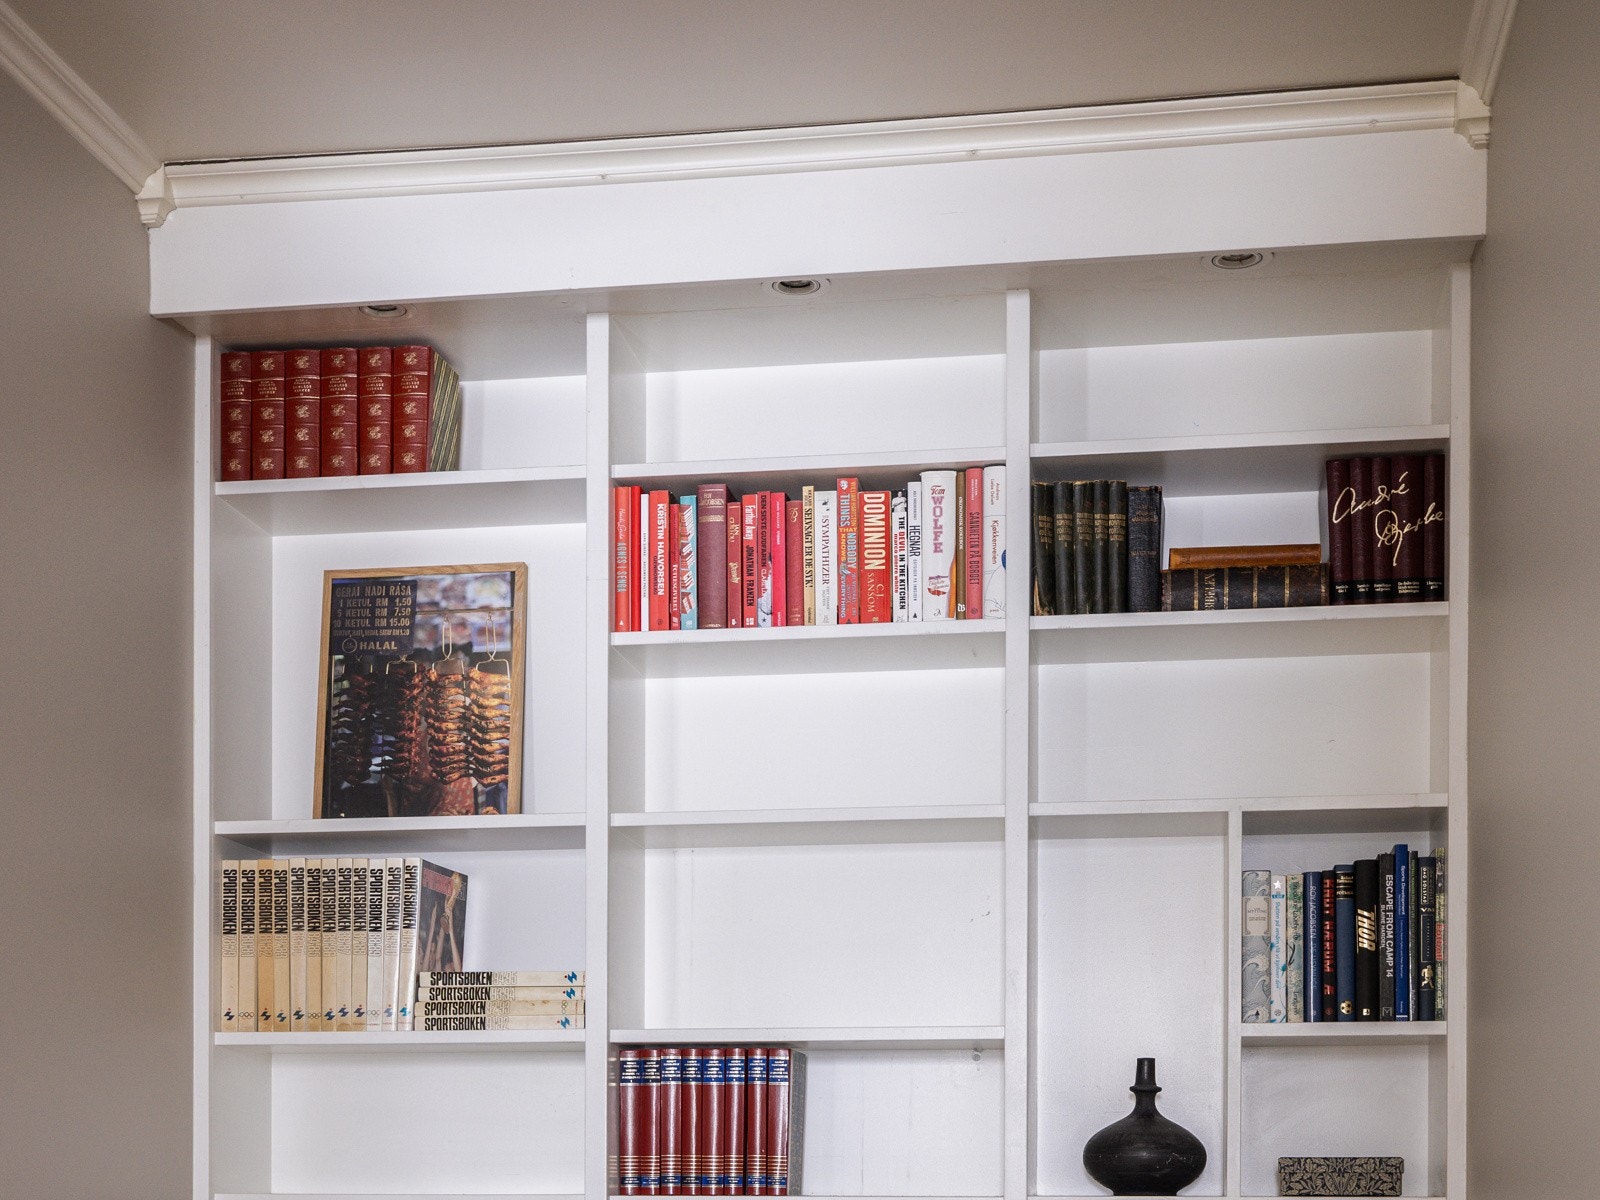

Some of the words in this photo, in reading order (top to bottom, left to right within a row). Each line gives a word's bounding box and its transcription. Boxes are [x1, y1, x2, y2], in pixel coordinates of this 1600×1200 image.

[745, 505, 755, 525] Farther
[840, 494, 850, 526] THINGS
[931, 496, 944, 553] WOLFE
[743, 526, 755, 540] Away
[804, 508, 812, 546] SELVSAGT
[864, 494, 886, 569] DOMINION
[909, 525, 920, 557] HEGNAR
[969, 511, 979, 548] SANNHETEN
[617, 542, 627, 563] AGNES
[746, 545, 754, 576] JONATHAN
[805, 547, 812, 557] ER
[805, 558, 812, 569] DE
[846, 532, 856, 568] NOBODY
[899, 554, 905, 562] IN
[970, 550, 981, 558] PÅ
[617, 571, 627, 592] SENGA
[970, 560, 979, 585] BORDET
[346, 598, 372, 607] KETUL
[376, 598, 388, 607] RM
[395, 597, 411, 606] 1.50
[365, 586, 386, 596] NADI
[390, 585, 411, 596] RASA
[746, 580, 754, 607] FRANZEN
[867, 572, 875, 612] SANSOM
[876, 584, 884, 599] C.J.
[345, 619, 370, 627] KETUL
[375, 618, 387, 626] RM
[390, 618, 410, 626] 15.00
[375, 608, 387, 616] RM
[394, 607, 411, 616] 7.50
[360, 641, 397, 650] HALAL
[223, 869, 237, 934] SPORTSBOKEN
[241, 869, 255, 934] SPORTSBOKEN
[259, 869, 272, 933] SPORTSBOKEN
[274, 869, 288, 933] SPORTSBOKEN
[291, 867, 305, 931] SPORTSBOKEN
[307, 868, 321, 931] SPORTSBOKEN
[323, 868, 336, 932] SPORTSBOKEN
[338, 867, 352, 931] SPORTSBOKEN
[354, 867, 367, 931] SPORTSBOKEN
[369, 868, 383, 932] SPORTSBOKEN
[386, 867, 401, 930] SPORTSBOKEN
[403, 865, 419, 929] SPORTSBOKEN
[1358, 909, 1376, 951] THOR
[430, 972, 492, 985] SPORTSBOKEN
[1386, 968, 1393, 977] 14
[424, 1002, 486, 1015] SPORTSBOKEN
[429, 987, 491, 1000] SPORTSBOKEN
[424, 1017, 486, 1030] SPORTSBOKEN
